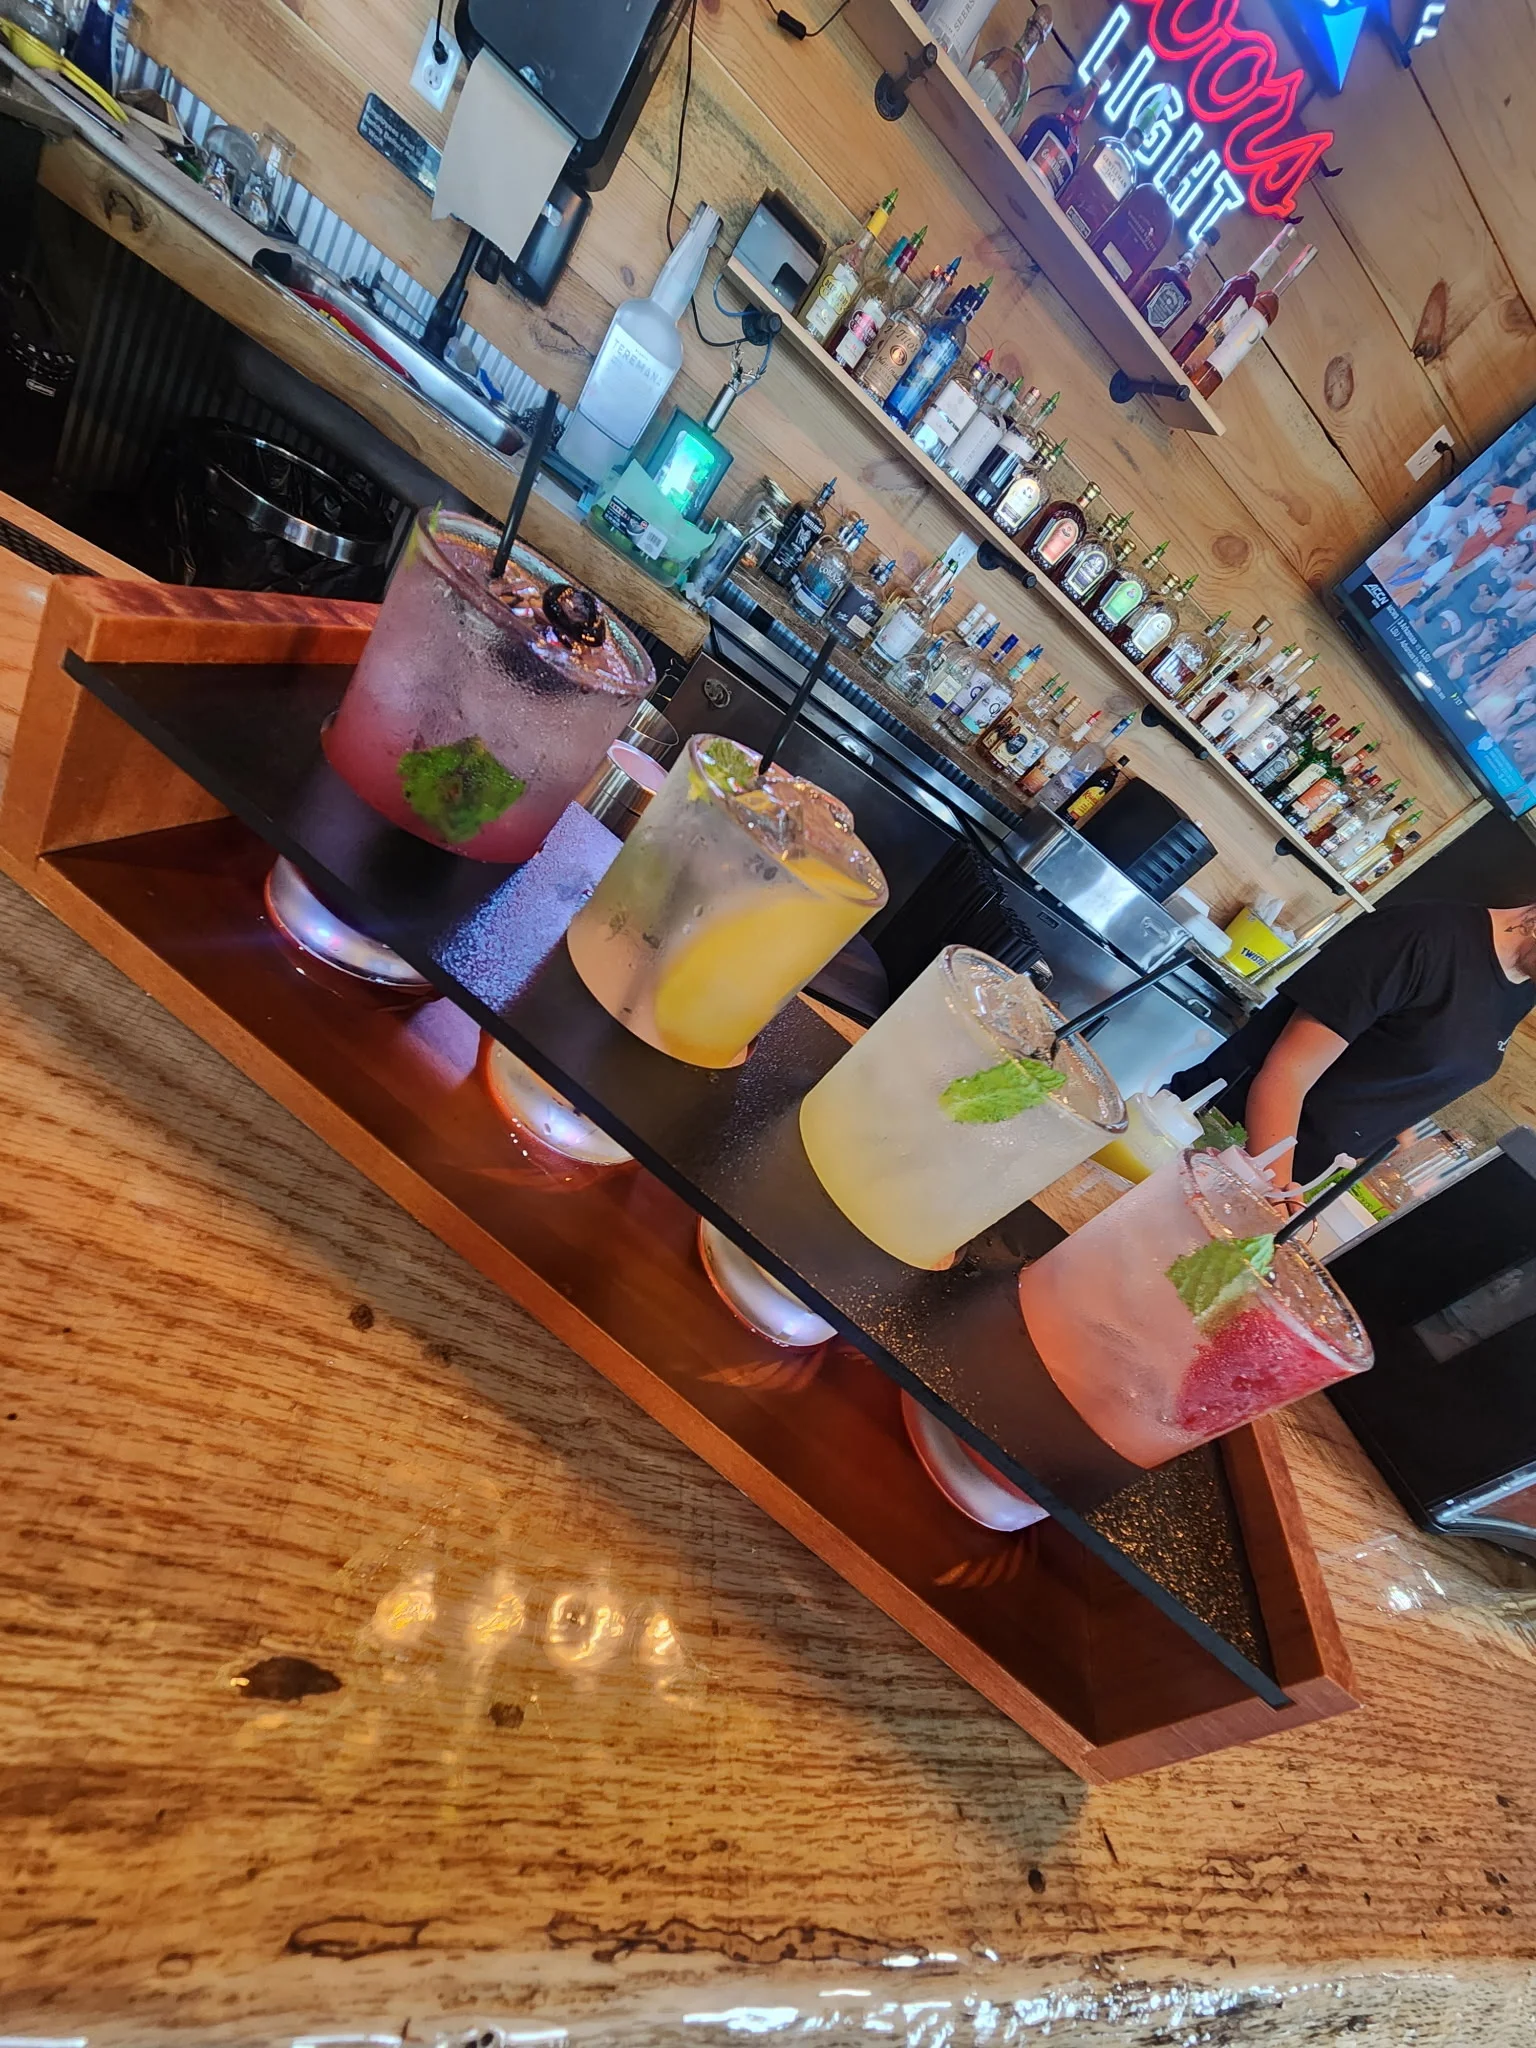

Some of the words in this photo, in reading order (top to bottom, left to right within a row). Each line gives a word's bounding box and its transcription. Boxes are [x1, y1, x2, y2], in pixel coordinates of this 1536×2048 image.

[1078, 4, 1245, 243] LIGHT
[1129, 0, 1335, 219] oors
[366, 128, 386, 147] Work
[1101, 153, 1129, 189] GENTLEMAN
[1103, 168, 1118, 185] JACK
[894, 328, 921, 354] Tito's
[611, 338, 665, 388] TEREMANA
[1362, 583, 1389, 604] ACCN
[1389, 626, 1400, 638] LSU
[1399, 622, 1418, 646] Arkansas
[1421, 650, 1433, 664] LSU
